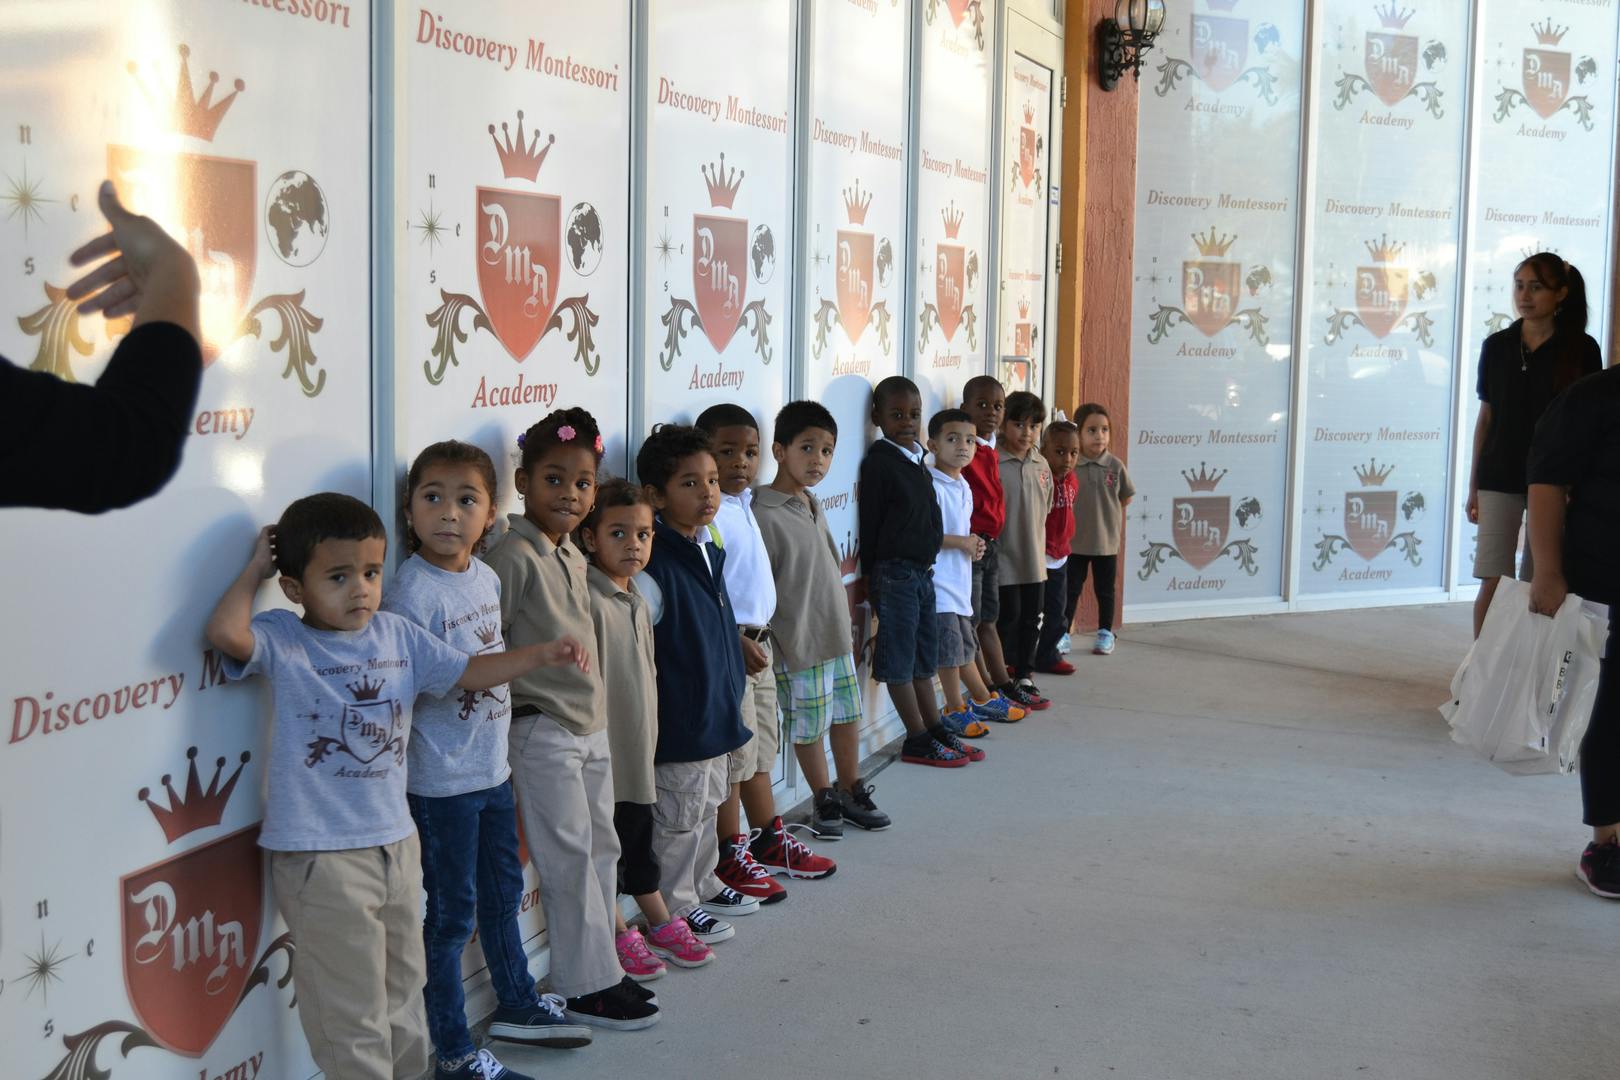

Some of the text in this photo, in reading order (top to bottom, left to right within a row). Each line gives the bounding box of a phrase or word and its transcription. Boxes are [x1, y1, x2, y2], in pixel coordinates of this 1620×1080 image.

[242, 0, 350, 28] essori
[416, 9, 619, 91] Discovery Montessori
[657, 77, 787, 134] Discovery Montessori
[1184, 96, 1246, 118] Academy
[1359, 110, 1415, 130] Academy
[813, 118, 903, 161] Discovery Montessori
[1516, 122, 1568, 141] Academy
[1147, 189, 1288, 212] Discovery Montessori
[1325, 198, 1453, 220] Discovery Montessori
[1485, 207, 1601, 228] Discovery Montessori
[932, 348, 961, 370] Academy
[1176, 342, 1237, 359] Academy
[1350, 343, 1403, 361] Academy
[832, 352, 872, 376] Academy
[688, 362, 744, 390] Academy
[471, 373, 557, 409] Academy
[1137, 429, 1278, 447] Discovery Montessori
[1314, 427, 1440, 443] Discovery Montessori
[820, 487, 849, 512] covery
[1166, 576, 1226, 591] Academy
[1338, 565, 1393, 581] Academy
[8, 672, 185, 744] Discovery
